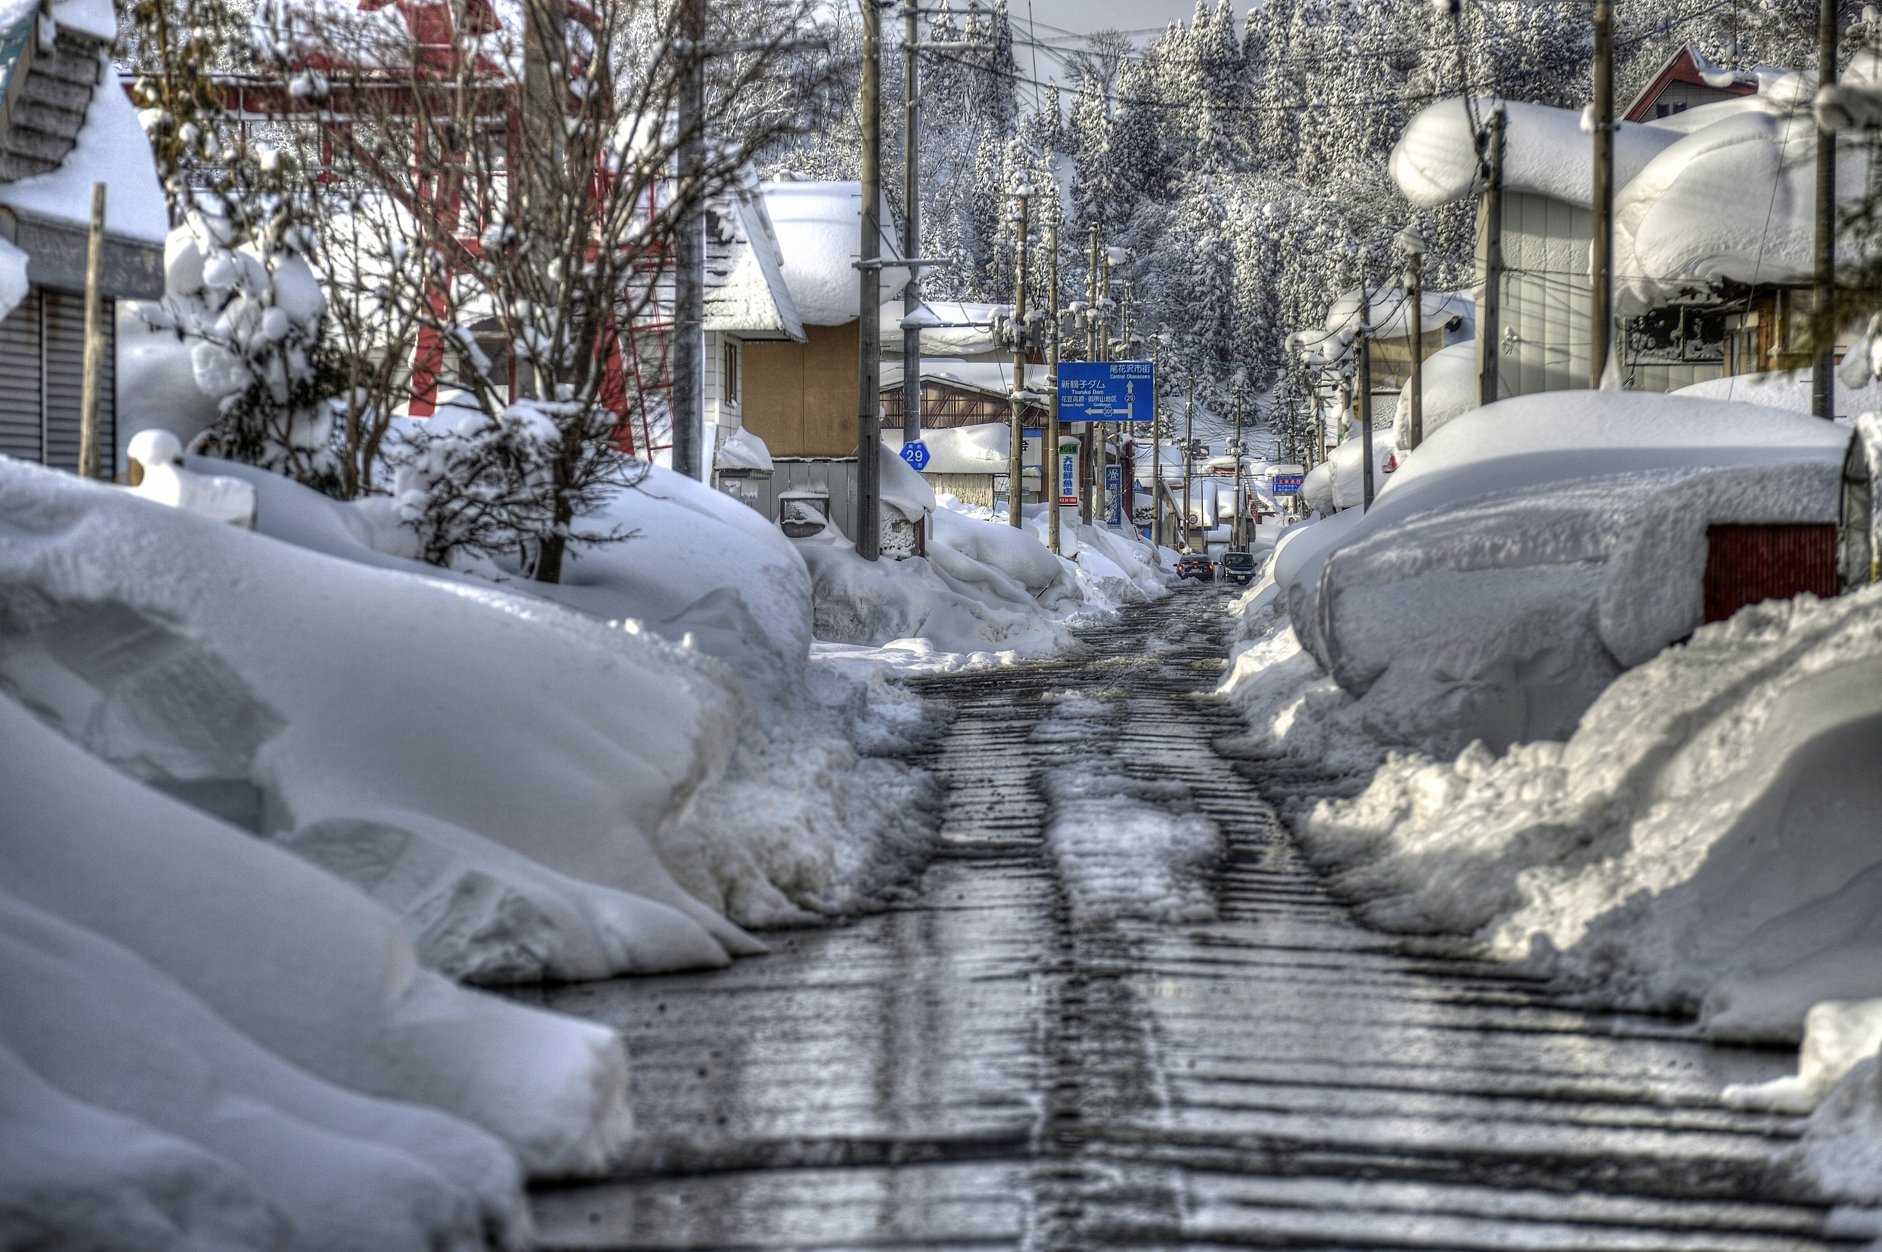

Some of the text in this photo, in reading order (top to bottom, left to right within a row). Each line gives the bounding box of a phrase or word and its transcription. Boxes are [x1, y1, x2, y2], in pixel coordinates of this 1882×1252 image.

[1110, 364, 1151, 374] 尾花沢市街
[1061, 380, 1106, 389] 新鶴子ダム
[906, 449, 923, 462] 29
[1062, 455, 1073, 496] 大沼鮮魚店
